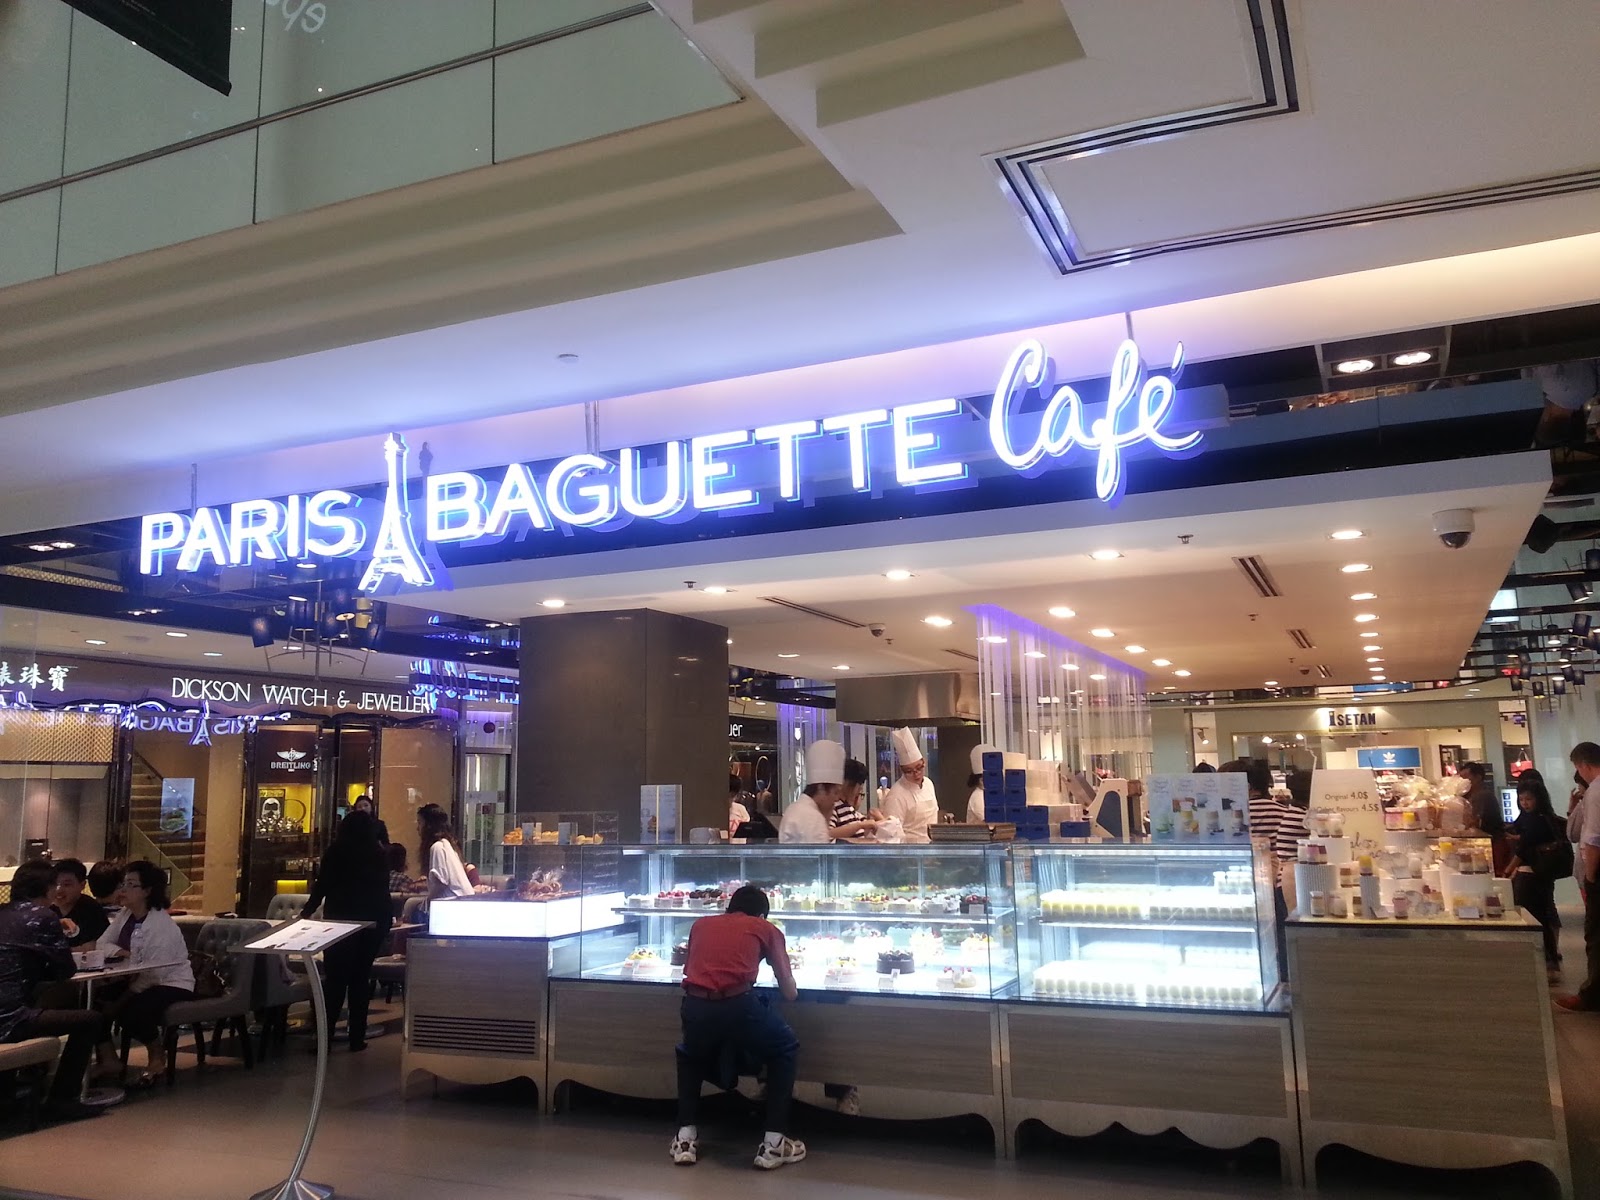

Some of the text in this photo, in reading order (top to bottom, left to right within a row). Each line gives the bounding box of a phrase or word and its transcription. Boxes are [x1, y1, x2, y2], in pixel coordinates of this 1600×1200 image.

[140, 338, 1202, 575] PARIS BAGUETTE Café
[171, 677, 435, 714] DICKSON WATCH & JEWELLER
